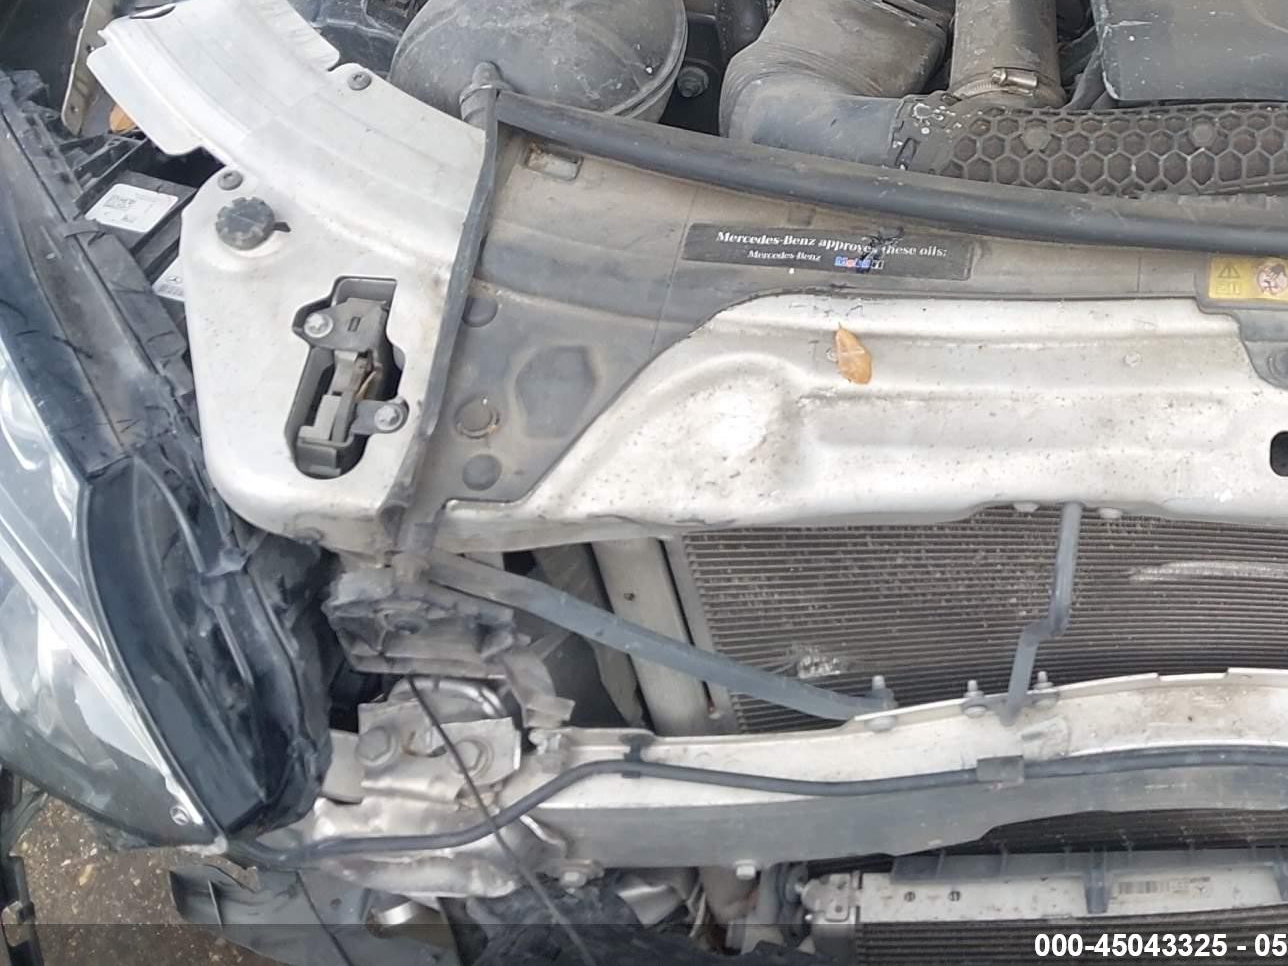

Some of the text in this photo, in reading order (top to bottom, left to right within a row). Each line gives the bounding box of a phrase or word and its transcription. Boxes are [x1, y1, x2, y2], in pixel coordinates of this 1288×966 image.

[716, 231, 816, 246] Mercedes-Benz
[882, 246, 916, 255] these
[747, 250, 821, 262] Mercedes-Benz
